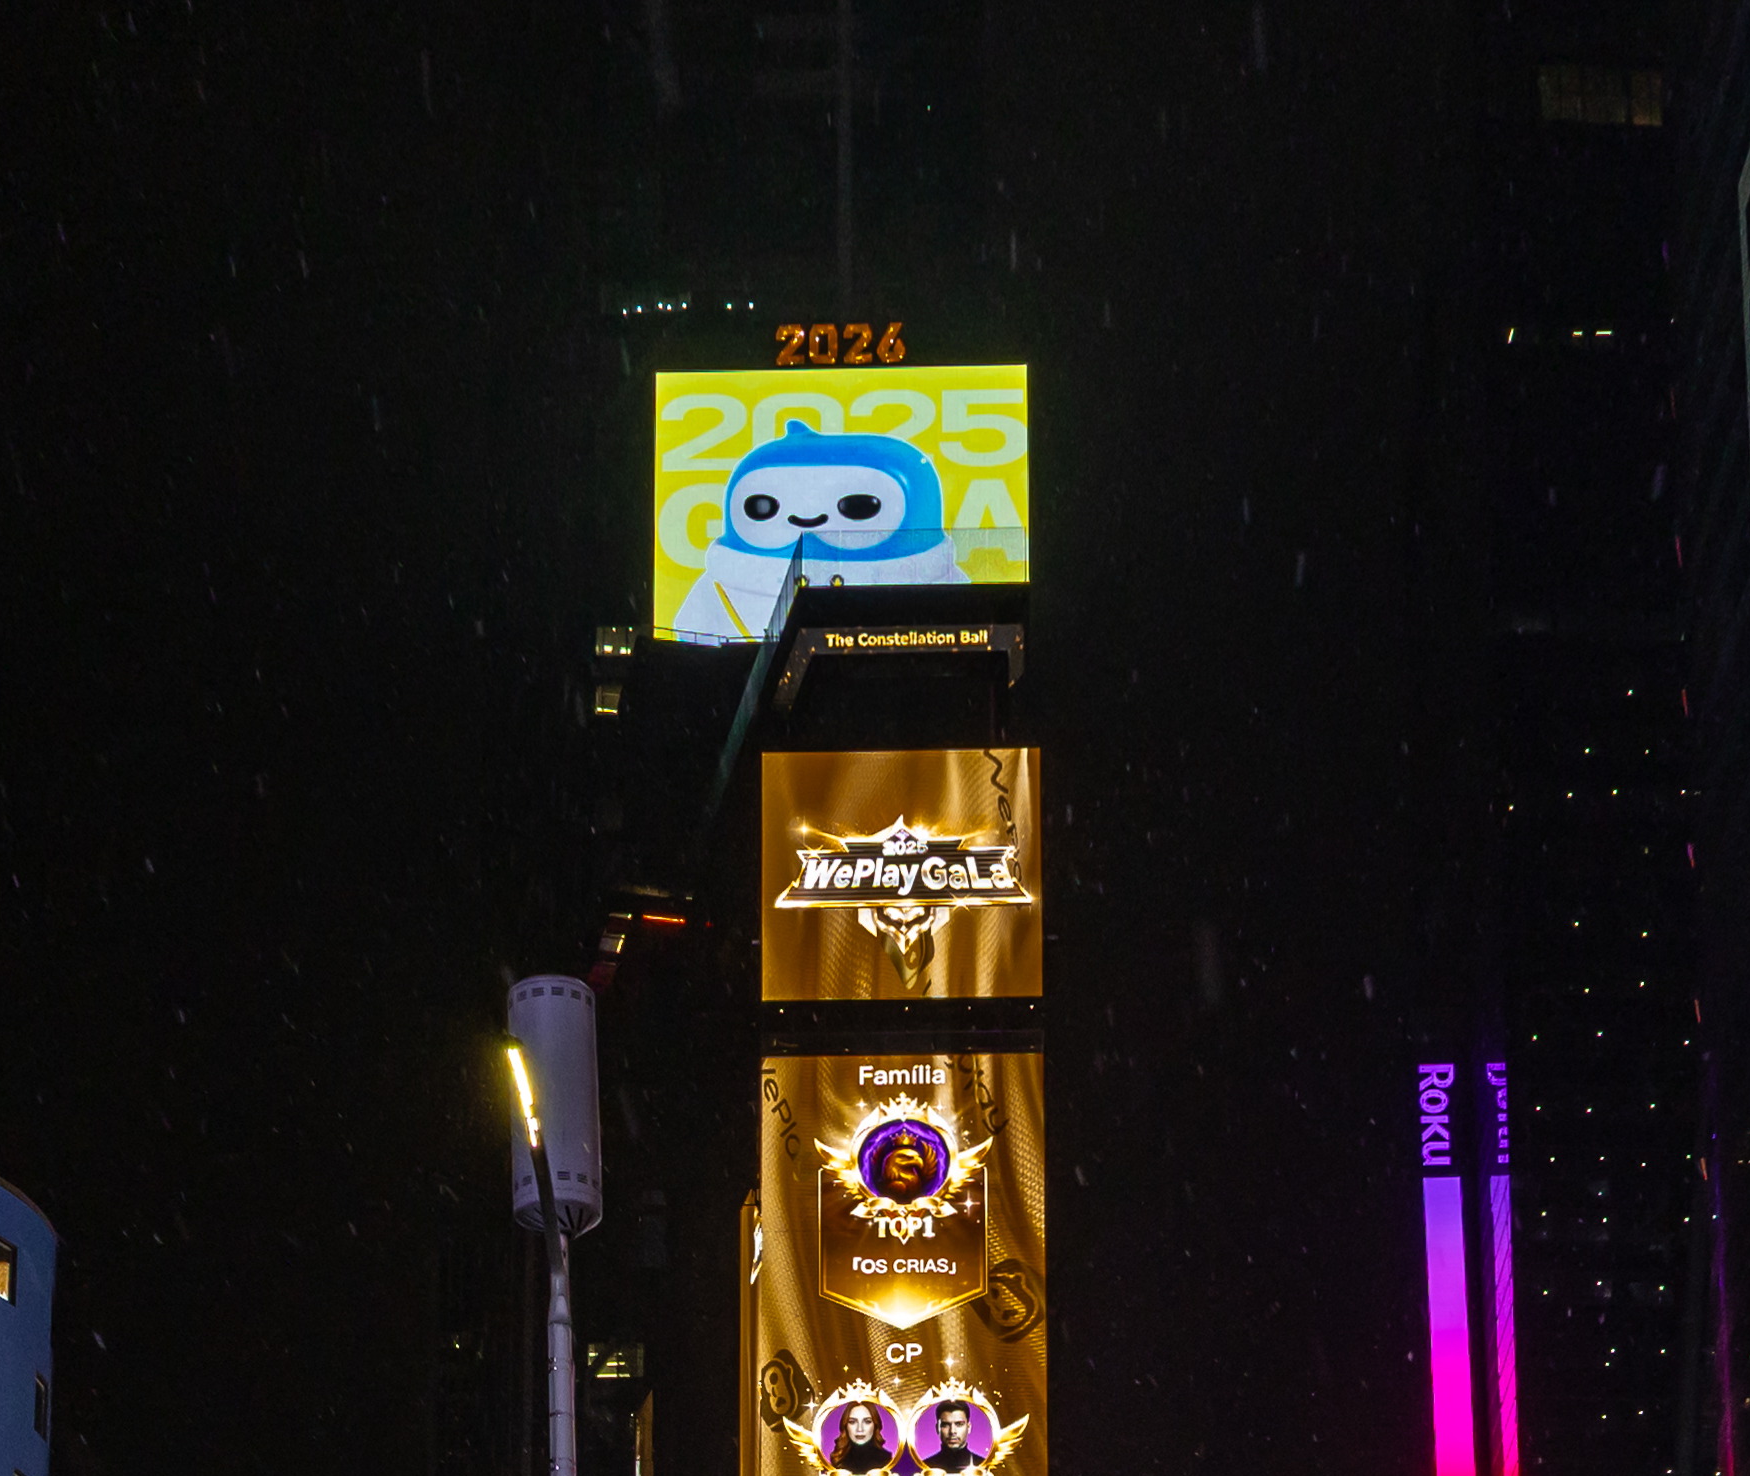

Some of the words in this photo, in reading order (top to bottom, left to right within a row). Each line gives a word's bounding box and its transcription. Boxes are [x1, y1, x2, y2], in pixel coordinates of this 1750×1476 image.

[776, 322, 907, 366] 2026
[825, 634, 854, 649] The
[857, 632, 955, 648] Constellation
[960, 631, 989, 645] Ball
[885, 1342, 923, 1364] CP
